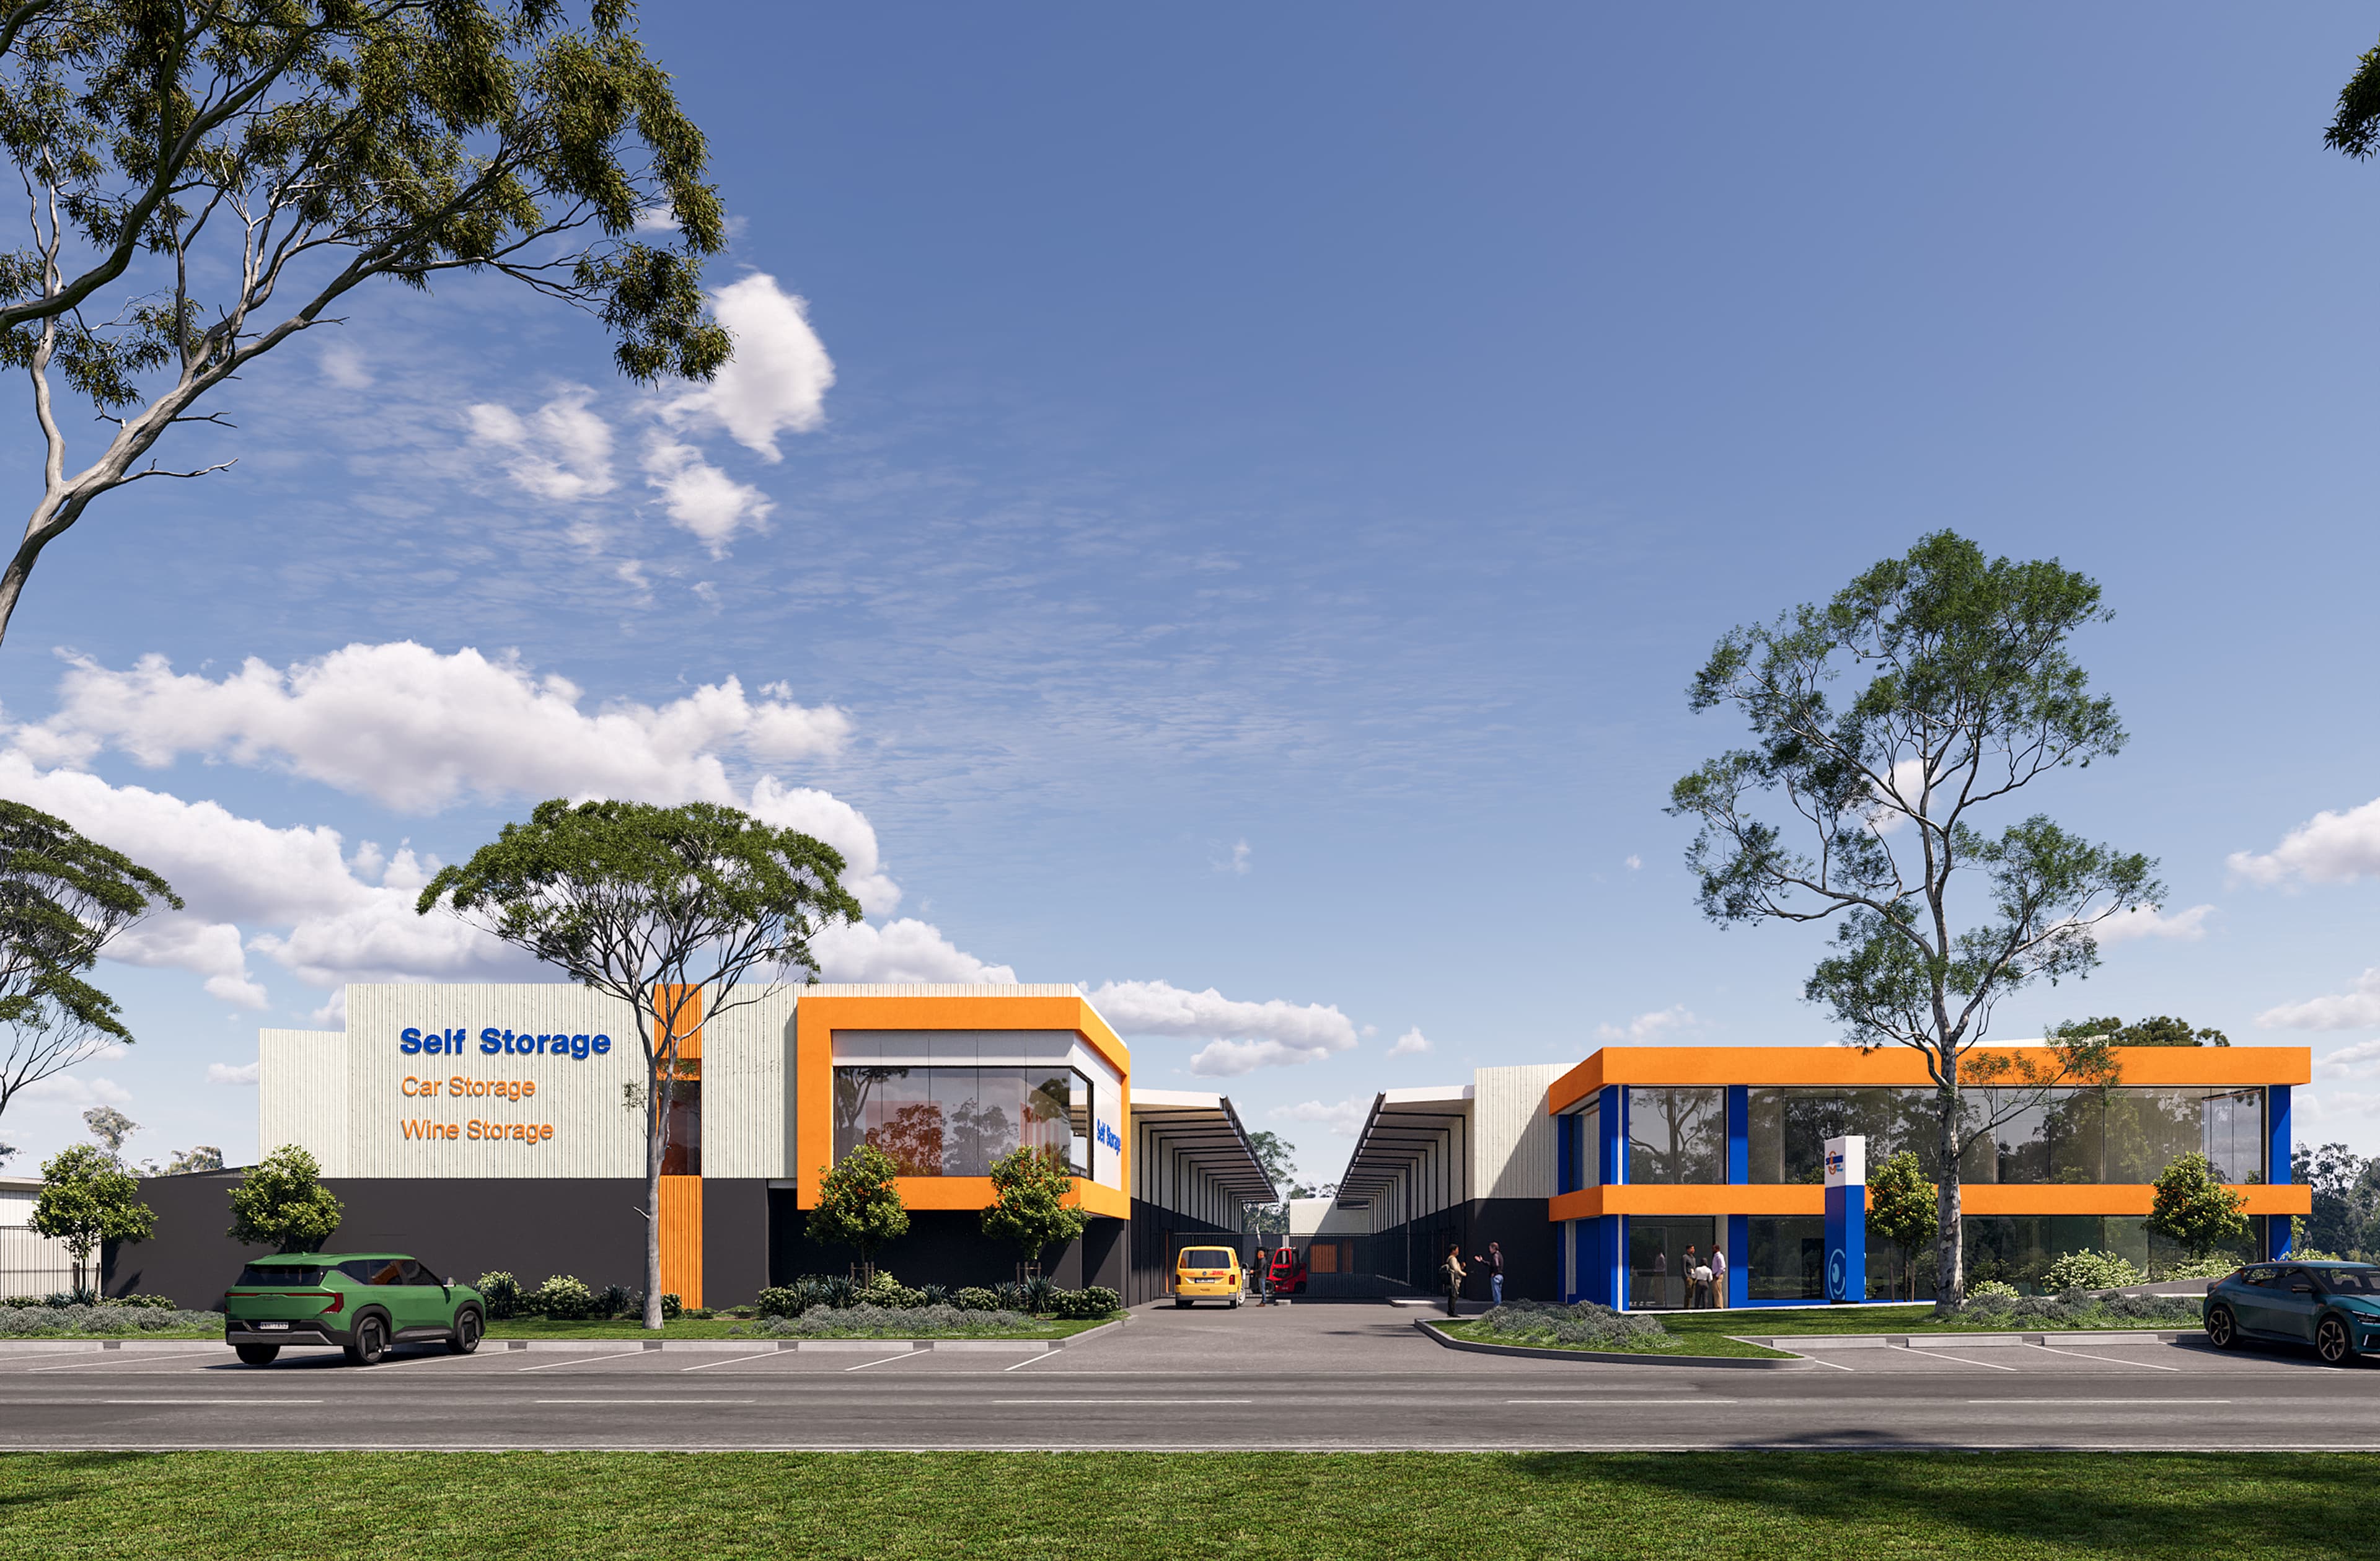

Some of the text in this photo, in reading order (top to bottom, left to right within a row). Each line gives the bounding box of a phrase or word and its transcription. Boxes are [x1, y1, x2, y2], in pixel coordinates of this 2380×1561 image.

[400, 1027, 610, 1060] Self Storage
[402, 1076, 536, 1101] Car Storage
[402, 1119, 554, 1144] Wine Storage
[1097, 1118, 1121, 1156] Self Storage
